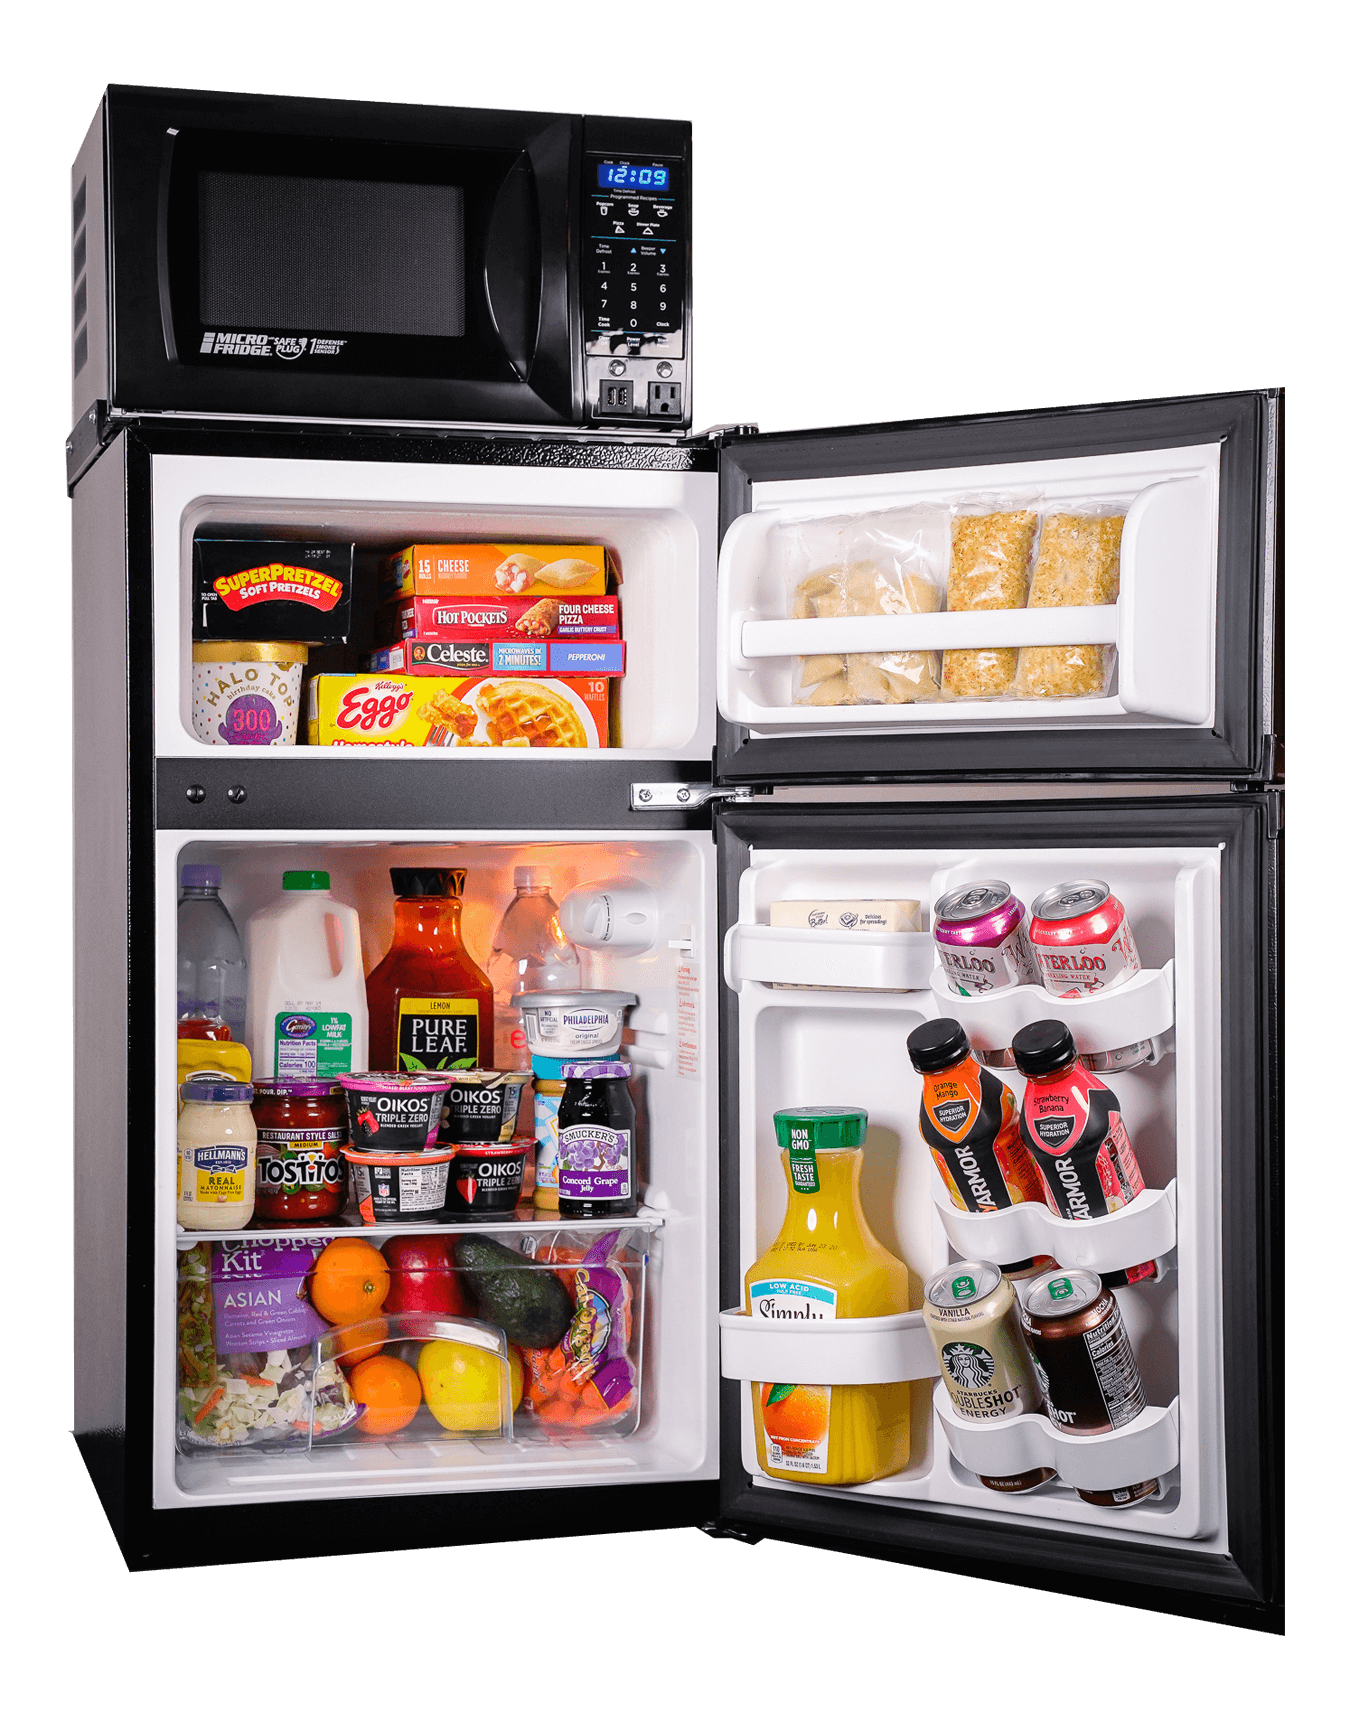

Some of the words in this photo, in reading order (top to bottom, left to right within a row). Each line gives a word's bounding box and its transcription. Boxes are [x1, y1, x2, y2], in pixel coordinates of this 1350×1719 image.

[608, 168, 666, 185] 12:09
[602, 262, 606, 270] 1
[630, 263, 637, 272] 2
[660, 264, 666, 273] 3
[601, 282, 607, 290] 4
[631, 283, 637, 291] 5
[660, 284, 666, 292] 6
[602, 300, 607, 308] 7
[630, 301, 637, 309] 8
[660, 302, 666, 310] 9
[630, 318, 637, 327] 0
[216, 332, 268, 345] MICRO
[274, 338, 296, 346] SAFE
[213, 344, 271, 356] FRIDGE
[276, 345, 300, 353] PLUG
[419, 560, 430, 572] 15
[438, 560, 469, 572] CHEESE
[240, 584, 268, 599] SOFT
[270, 582, 321, 599] PRETZELS
[559, 604, 581, 614] FOUR
[583, 604, 614, 614] CHEESE
[437, 610, 459, 624] HOT
[461, 610, 507, 624] POCKETS
[559, 615, 583, 625] PIZZA
[499, 655, 504, 666] 2
[505, 655, 541, 666] MINUTES!
[207, 668, 258, 707] HALO
[270, 672, 292, 706] TOP
[375, 681, 405, 692] Kellogg's
[588, 682, 604, 692] 10
[227, 685, 260, 700] birthday
[262, 688, 276, 700] cake
[584, 693, 605, 701] WAFFLES
[336, 687, 414, 730] Eggo
[233, 709, 270, 731] 300
[564, 1014, 609, 1025] PHILADELPHIA
[412, 1019, 467, 1035] PURE
[412, 1036, 466, 1052] LEAF
[934, 1082, 958, 1092] Orange
[450, 1089, 500, 1104] OIKOS
[936, 1090, 958, 1100] Mango
[1034, 1094, 1069, 1106] Strawberry
[377, 1097, 428, 1112] OIKOS
[480, 1105, 501, 1114] ZERO
[1039, 1104, 1064, 1114] Banana
[939, 1105, 964, 1117] SUPERIOR
[376, 1113, 406, 1123] TRIPLE
[408, 1113, 428, 1122] ZERO
[940, 1112, 967, 1123] HYDRATION
[1039, 1122, 1068, 1131] SUPERIOR
[262, 1132, 304, 1140] RESTAURANT
[306, 1132, 326, 1140] STYLE
[564, 1130, 615, 1144] SMUCKER'S
[791, 1129, 808, 1140] NON
[1039, 1129, 1070, 1137] HYDRATION
[791, 1140, 809, 1150] GMO
[198, 1150, 246, 1162] HELLMANN'S
[478, 1162, 521, 1177] OIKOS
[792, 1164, 814, 1173] FRESH
[209, 1177, 235, 1185] REAL
[562, 1176, 591, 1185] Concord
[594, 1177, 618, 1186] Grape
[794, 1172, 814, 1181] TASTE
[477, 1178, 504, 1186] TRIPLE
[1055, 1157, 1092, 1220] ARMOR
[222, 1250, 262, 1272] Kit
[790, 1284, 809, 1292] ACID
[224, 1290, 282, 1308] ASIAN
[939, 1308, 970, 1317] VANILLA
[1091, 1298, 1108, 1317] MOCHA
[1086, 1317, 1114, 1340] Nutrition
[1092, 1341, 1114, 1357] Calories
[957, 1389, 998, 1398] STARBUCKS
[960, 1407, 1006, 1418] ENERGY
